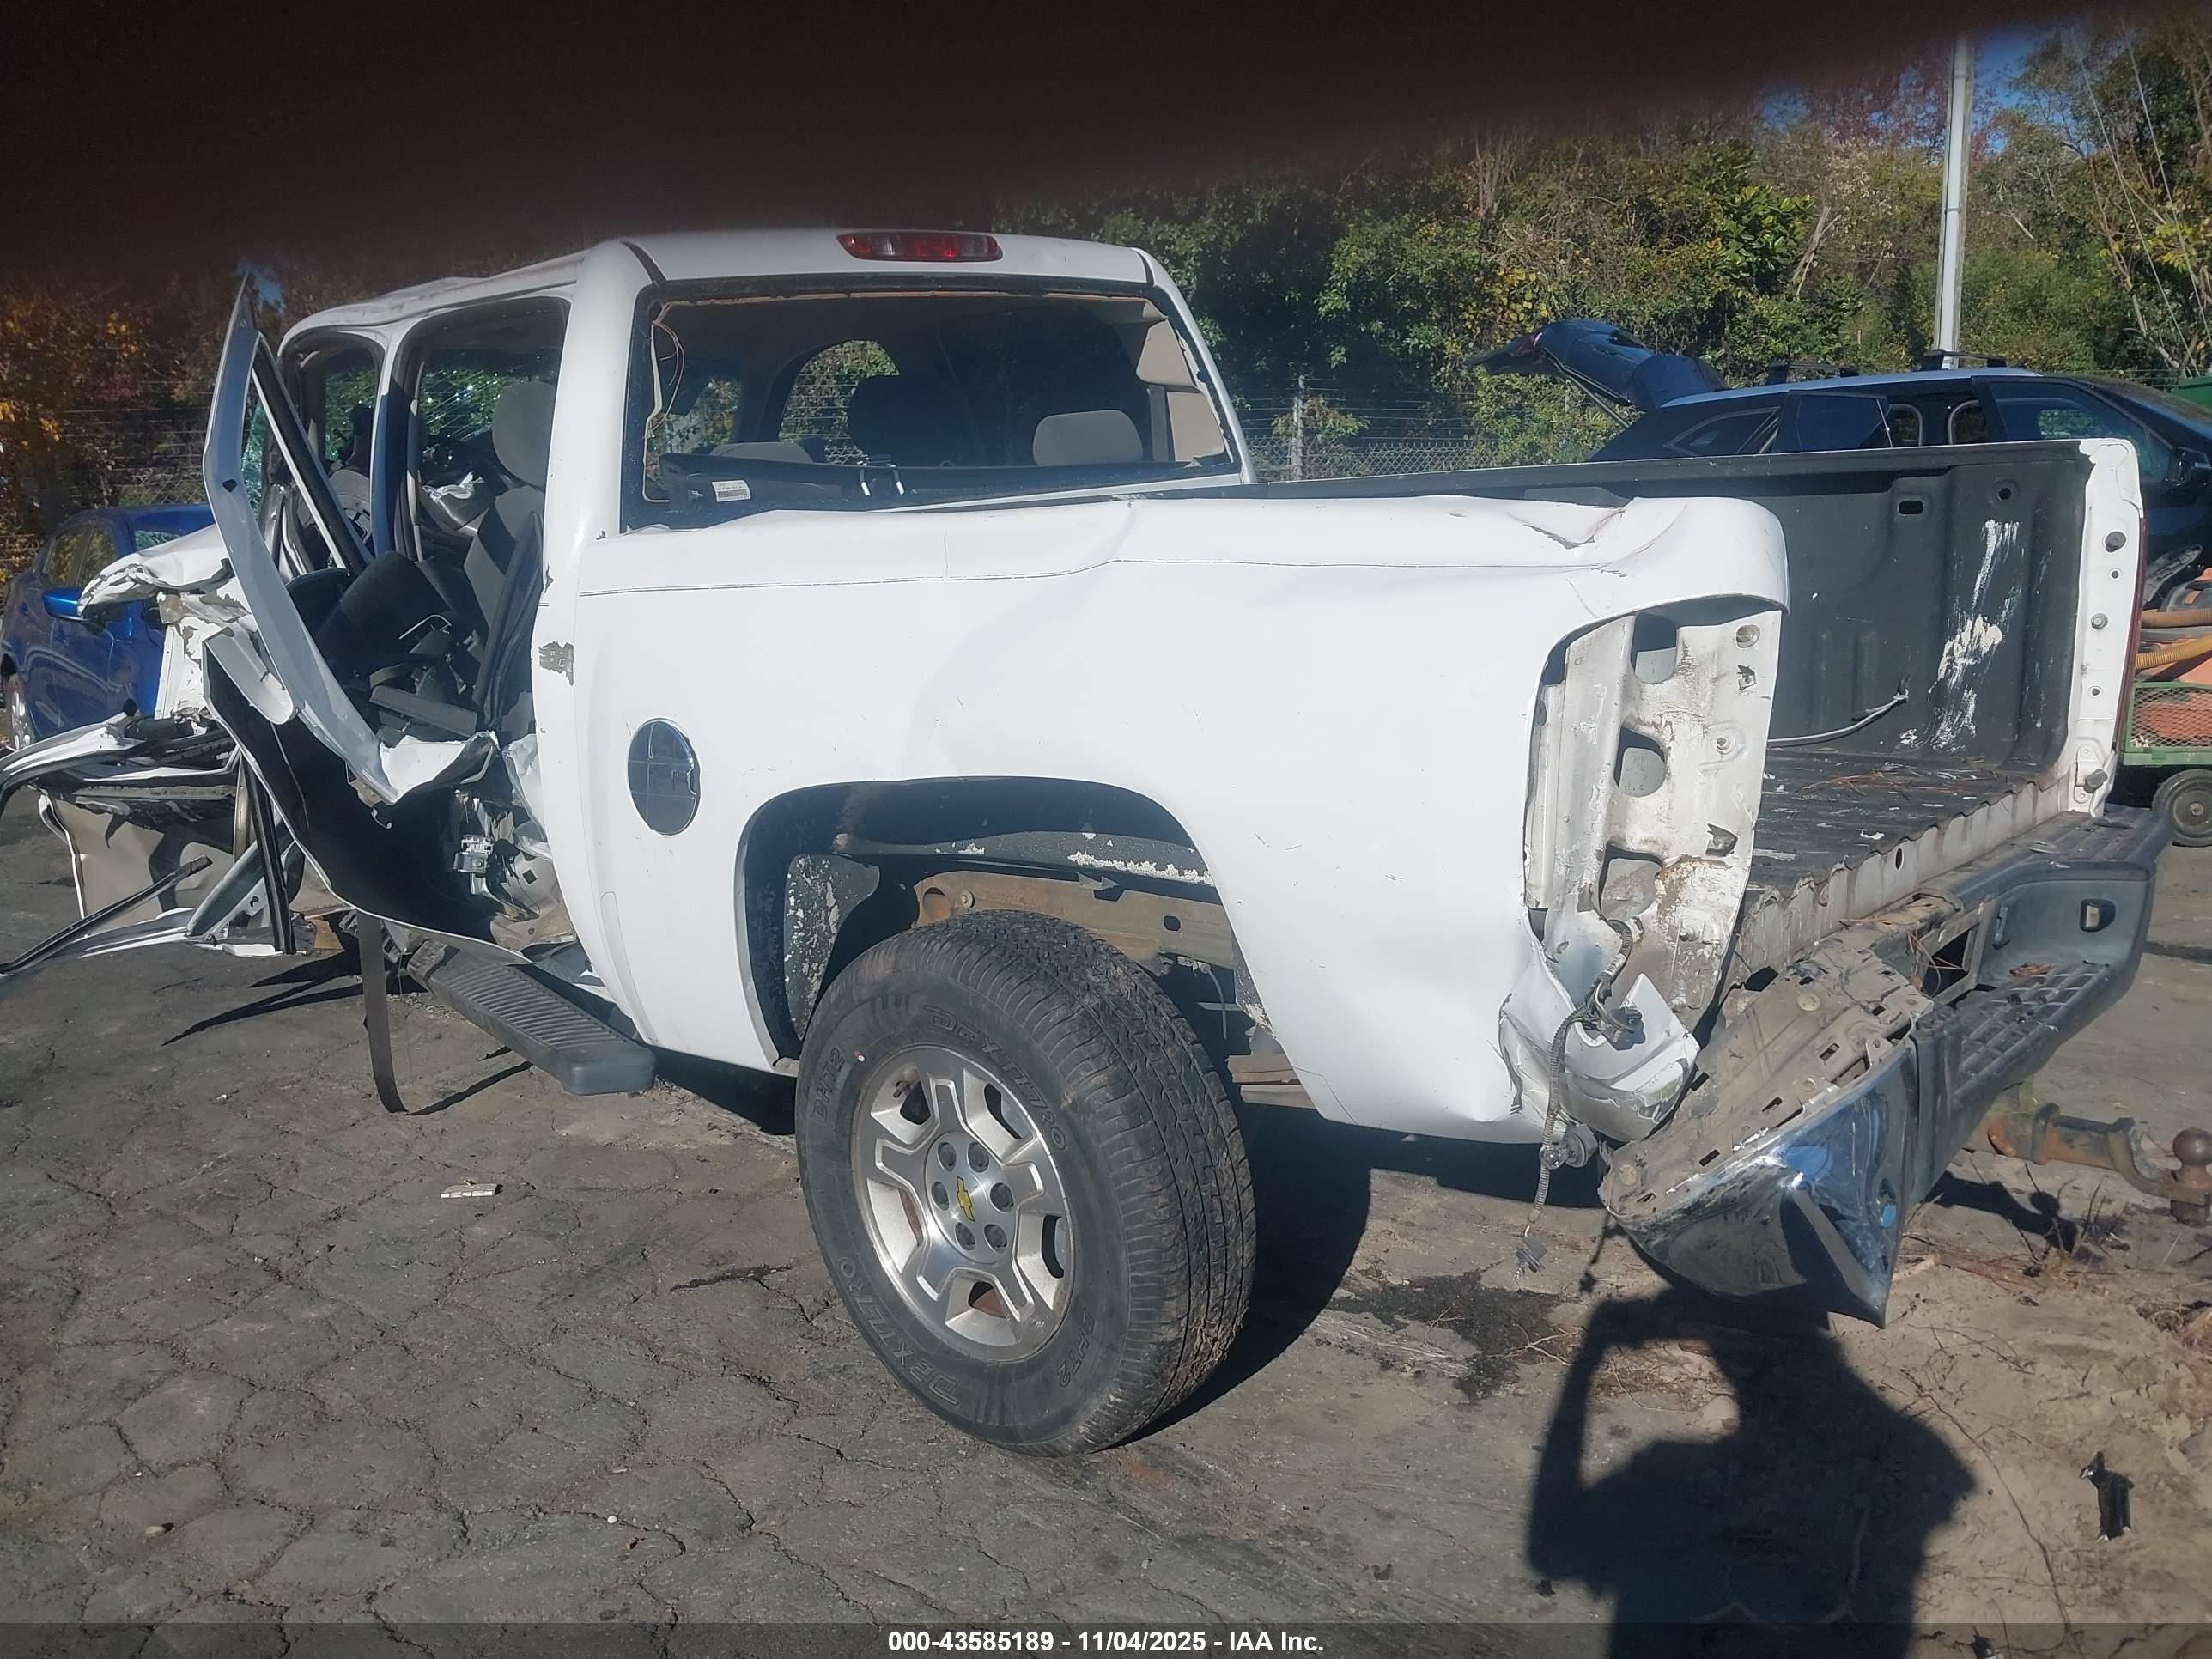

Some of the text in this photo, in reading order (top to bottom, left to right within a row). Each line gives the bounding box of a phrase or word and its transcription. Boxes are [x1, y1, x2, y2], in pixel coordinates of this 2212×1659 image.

[812, 1046, 845, 1123] DHT2
[839, 1256, 961, 1407] DEXTERO
[1057, 1306, 1097, 1388] DHT2
